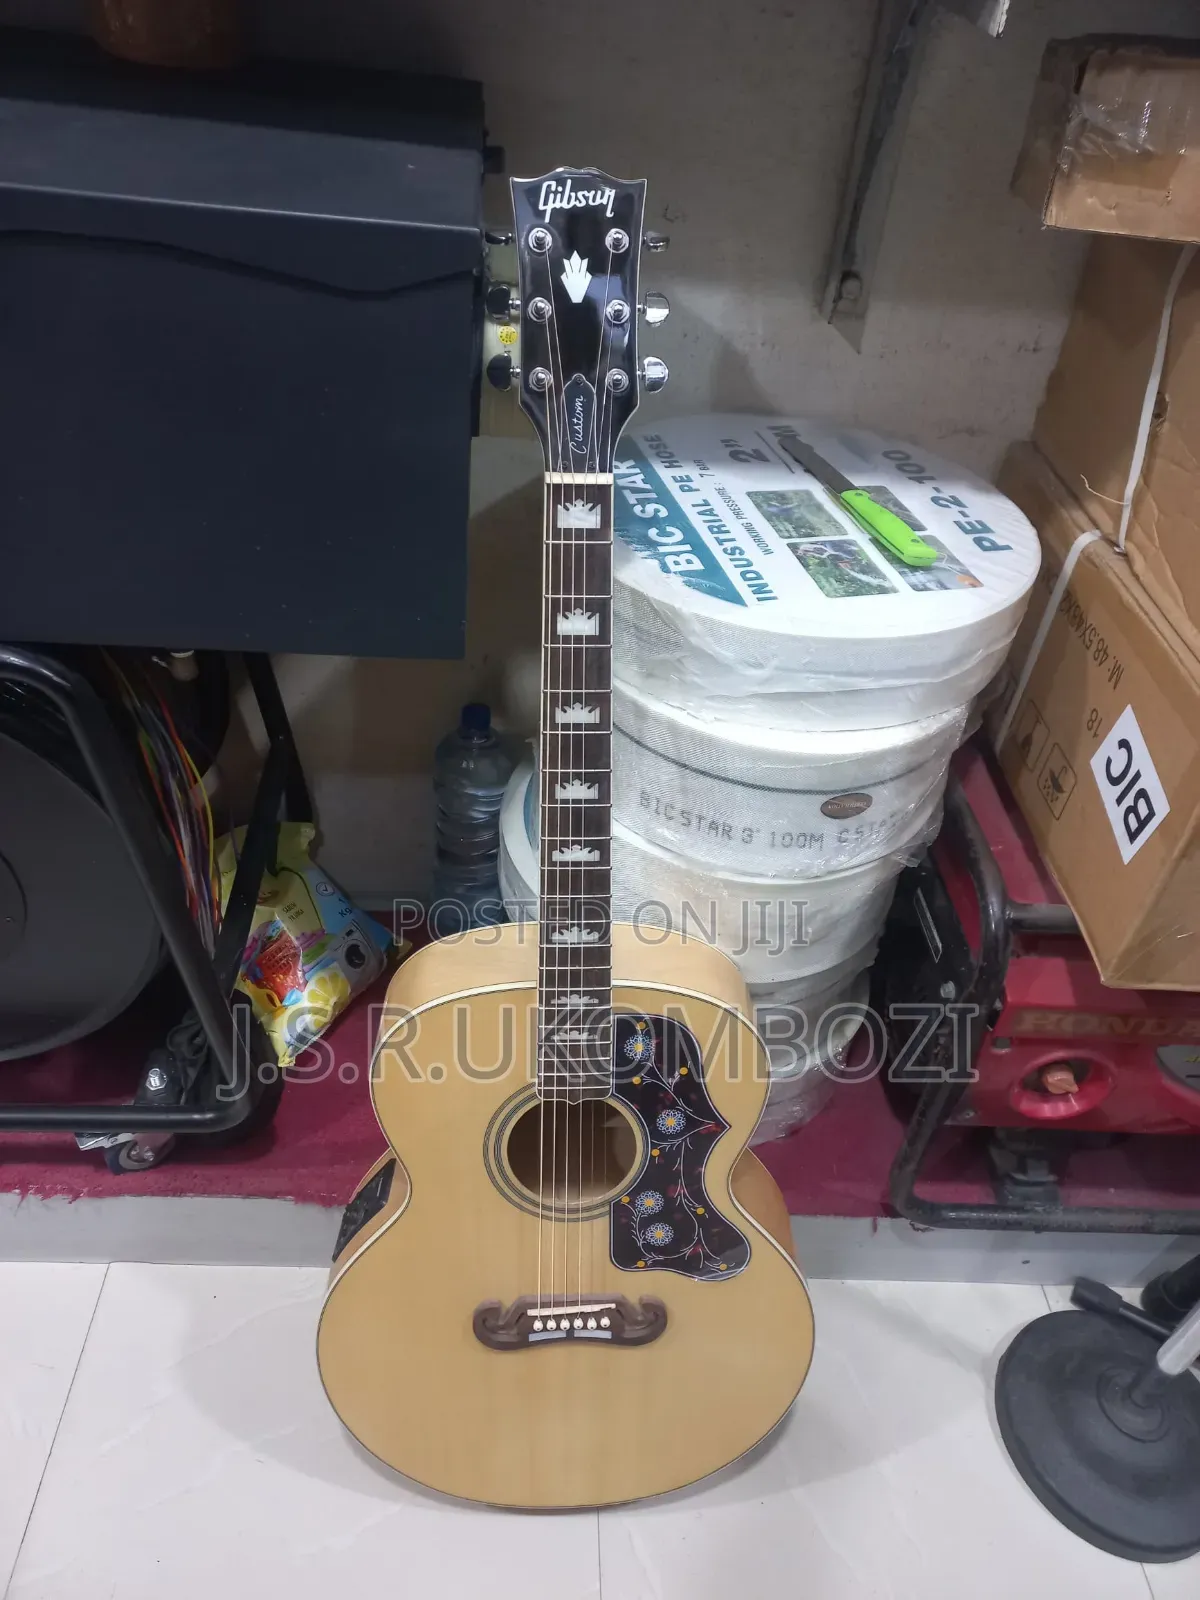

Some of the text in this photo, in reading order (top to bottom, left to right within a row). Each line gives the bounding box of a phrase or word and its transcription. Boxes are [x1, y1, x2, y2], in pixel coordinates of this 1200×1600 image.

[538, 179, 616, 223] Gibson
[569, 396, 584, 454] Custom
[613, 459, 705, 573] BIC STAR
[643, 434, 779, 602] INDUSTRIAL PE HOSE
[882, 450, 1013, 552] PE-2-100
[741, 521, 775, 556] WORKING
[1087, 708, 1103, 738] 18
[1105, 738, 1156, 845] BIC
[769, 830, 825, 851] 100M
